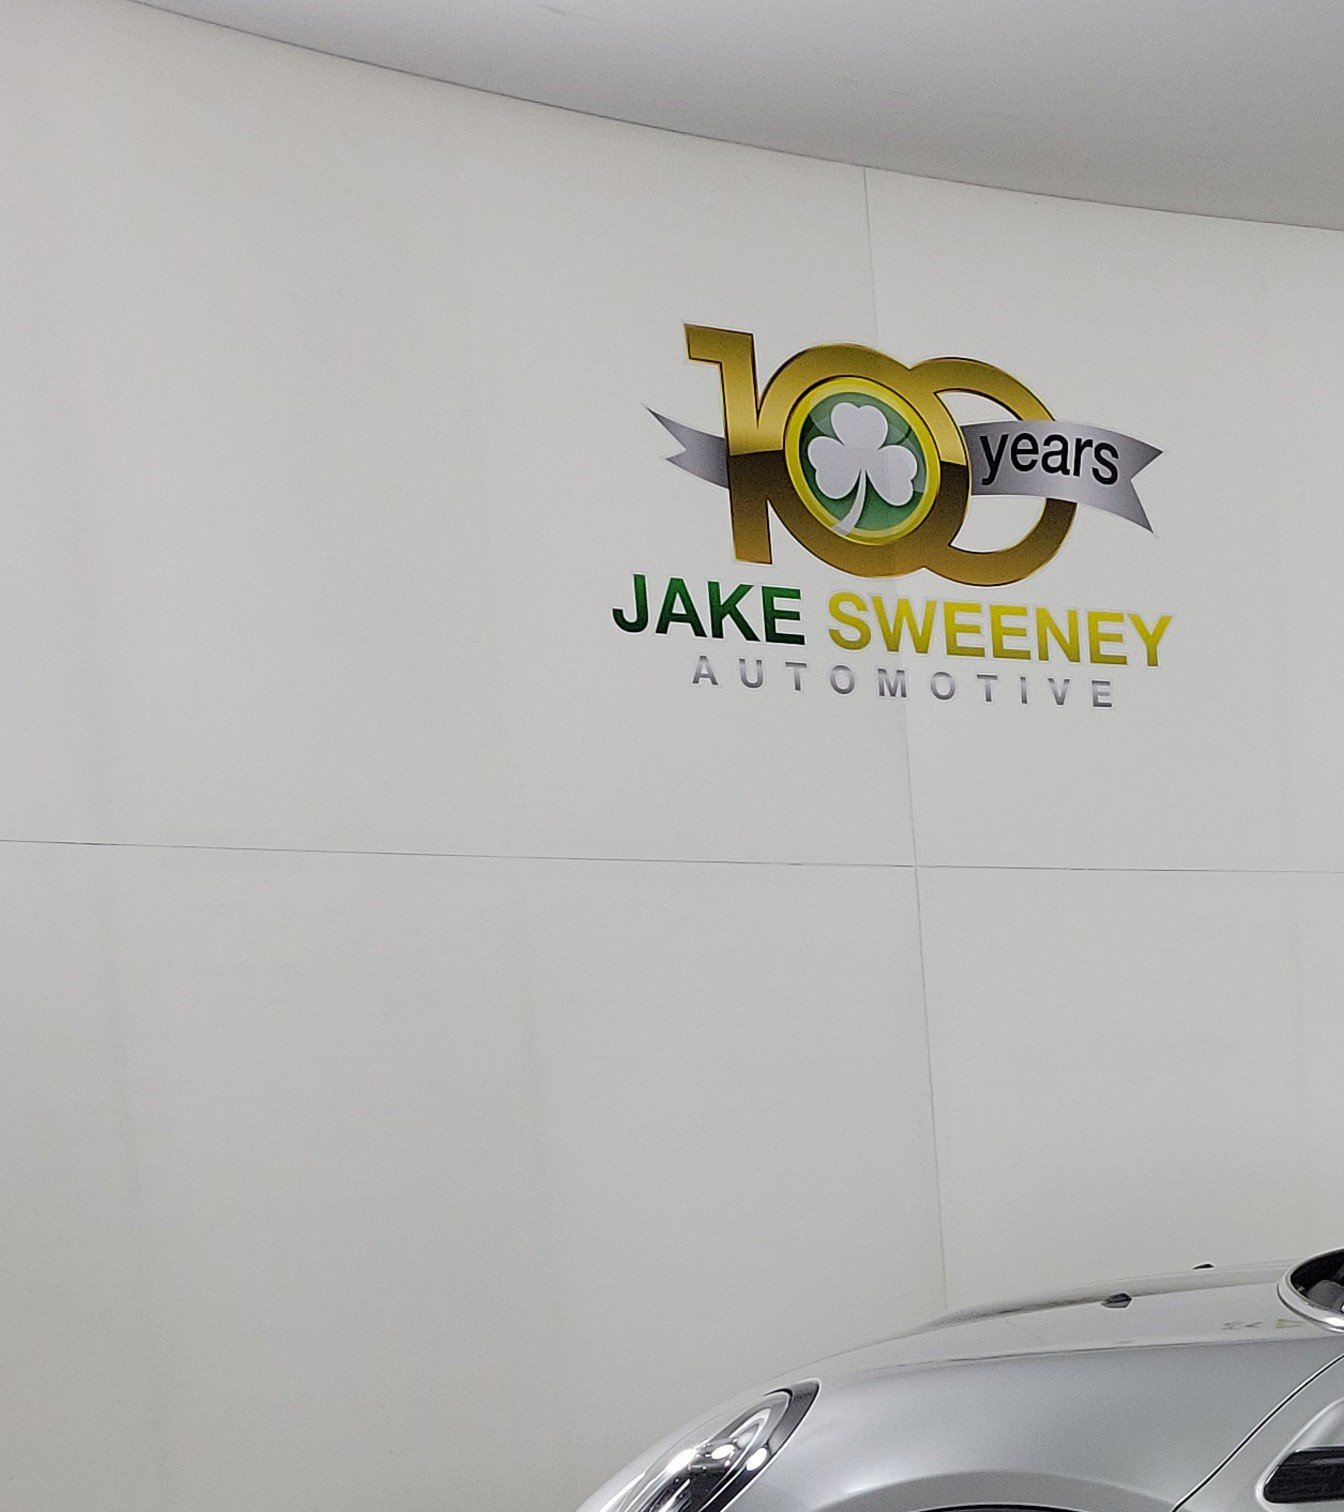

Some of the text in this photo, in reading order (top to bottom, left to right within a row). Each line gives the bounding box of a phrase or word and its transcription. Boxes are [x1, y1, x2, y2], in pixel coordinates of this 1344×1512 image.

[684, 323, 1120, 586] 100 years
[612, 573, 1172, 667] JAKE SWEENEY
[692, 655, 1113, 708] AUTOMOTIVE
